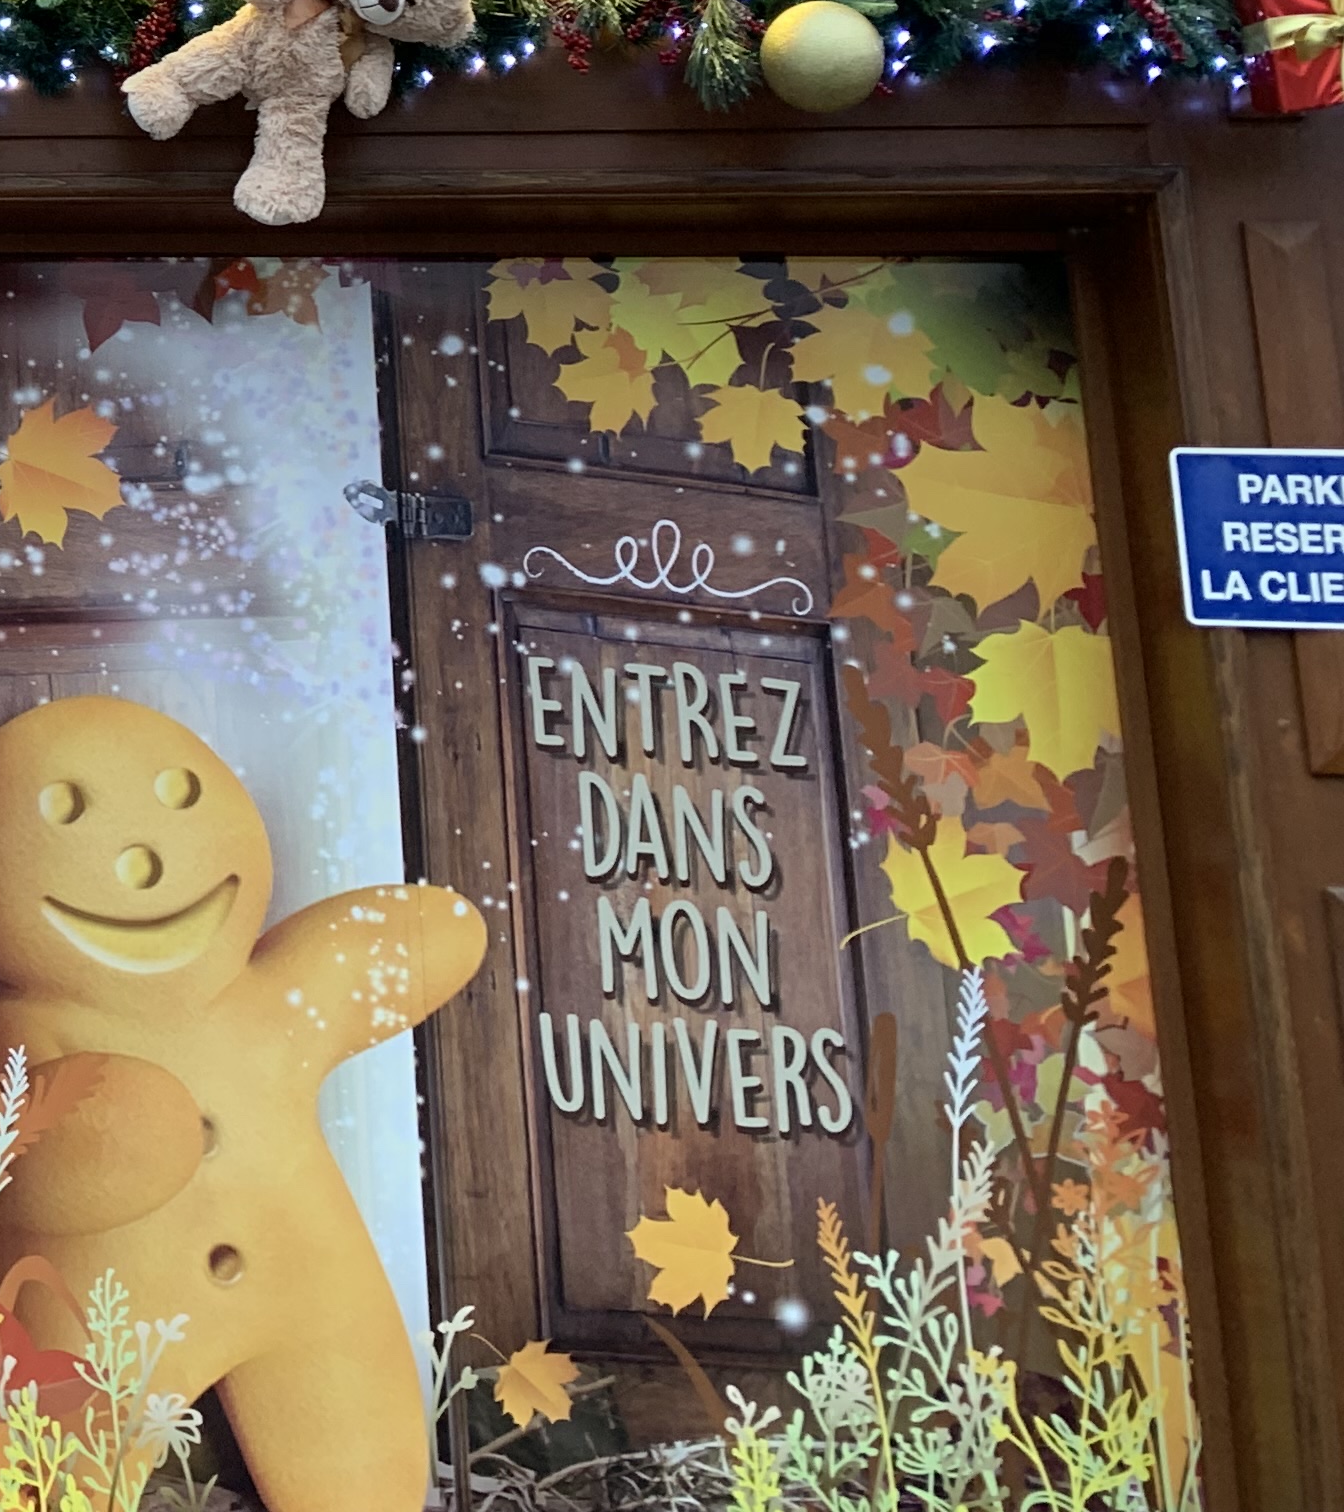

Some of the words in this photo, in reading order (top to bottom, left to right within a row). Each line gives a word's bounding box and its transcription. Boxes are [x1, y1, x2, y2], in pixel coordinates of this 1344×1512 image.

[1200, 569, 1253, 601] LA
[1259, 570, 1344, 604] CLIE
[1222, 520, 1344, 555] RESER
[526, 655, 809, 768] ENTREZ
[578, 771, 774, 888] DANS
[597, 896, 772, 1006] MON
[538, 1011, 854, 1135] UNIVERS
